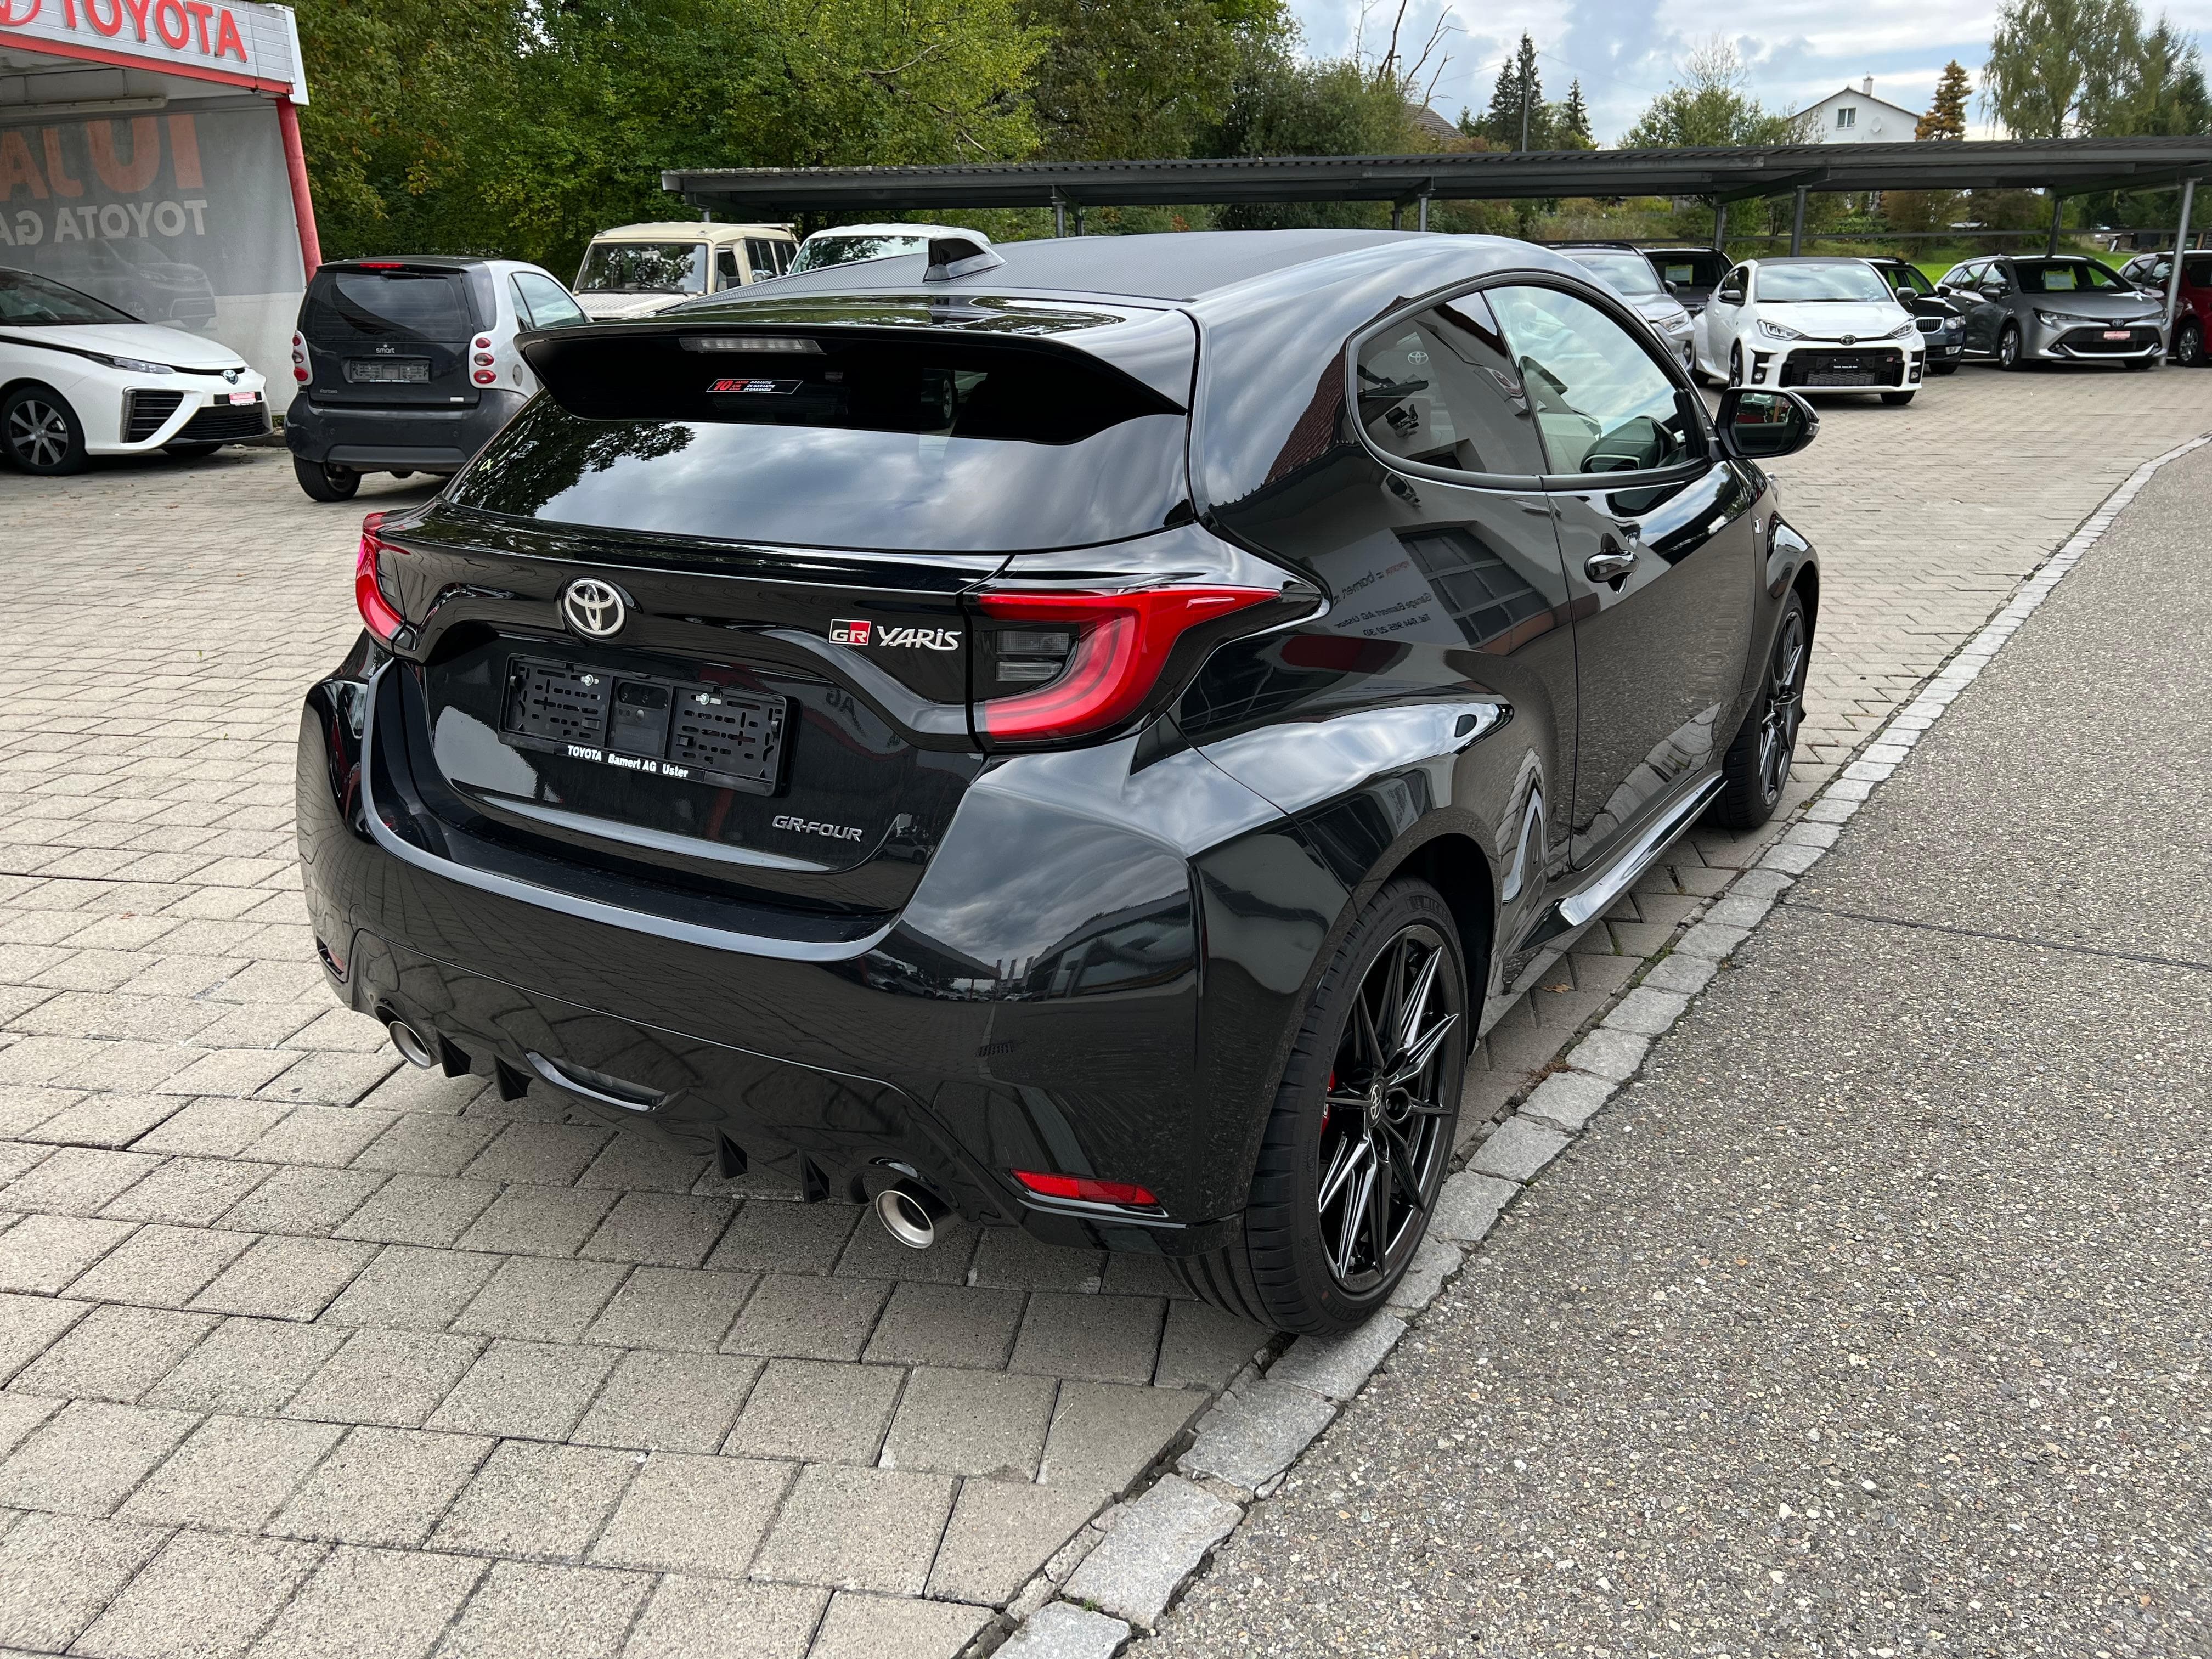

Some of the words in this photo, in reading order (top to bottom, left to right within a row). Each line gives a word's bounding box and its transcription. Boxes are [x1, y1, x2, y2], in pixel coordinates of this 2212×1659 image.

[713, 380, 733, 391] 10
[568, 745, 602, 761] TOYOTA
[608, 753, 641, 769] Bamert
[642, 760, 657, 772] AG
[662, 763, 689, 778] Uster
[772, 815, 863, 842] GR-FOUR
